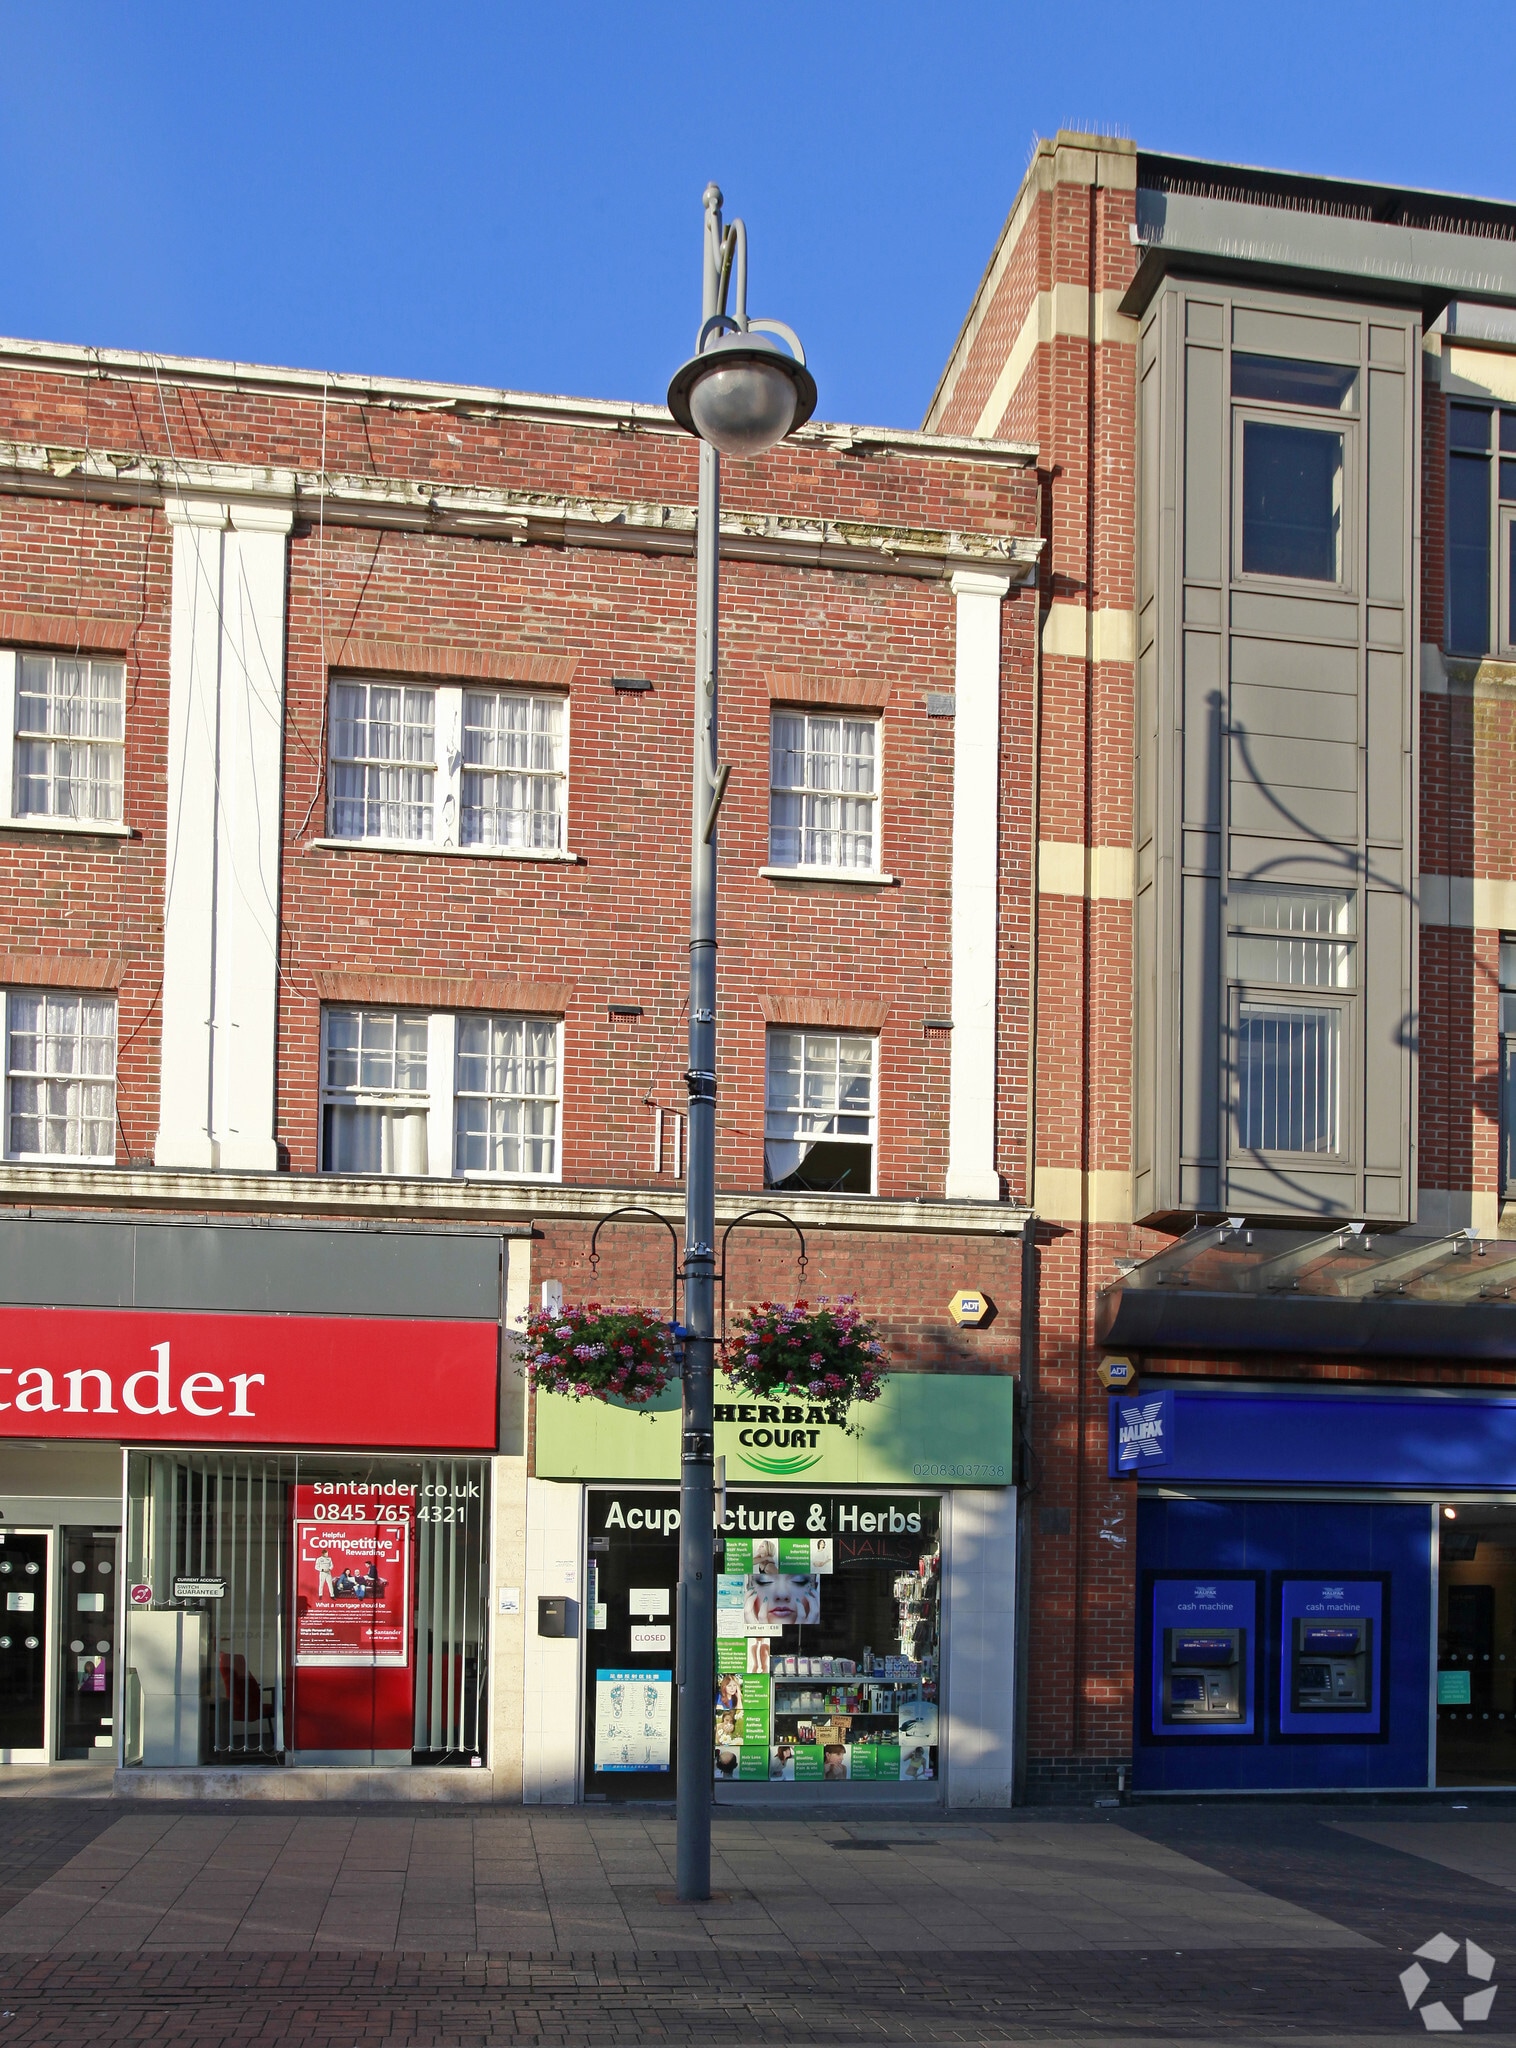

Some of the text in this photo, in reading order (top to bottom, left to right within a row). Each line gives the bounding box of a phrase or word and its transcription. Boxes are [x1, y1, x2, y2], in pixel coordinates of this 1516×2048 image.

[962, 1302, 979, 1310] ADT
[1110, 1367, 1127, 1375] ADT
[0, 1341, 265, 1417] ander
[713, 1404, 844, 1424] HERBAL
[739, 1428, 820, 1448] COURT
[1119, 1420, 1163, 1443] HALIFAX
[913, 1463, 1005, 1477] 02083037738
[313, 1479, 480, 1498] santander.co.uk
[313, 1503, 465, 1523] 0845 765 4321
[605, 1501, 921, 1536] Acupcture & Herbs
[309, 1537, 393, 1551] Competitive
[838, 1538, 912, 1559] NAILS
[345, 1549, 386, 1557] Rewarding
[695, 1571, 703, 1581] 9
[1178, 1603, 1234, 1611] cash machine
[1306, 1603, 1361, 1611] cash machine
[634, 1634, 666, 1642] CLOSED
